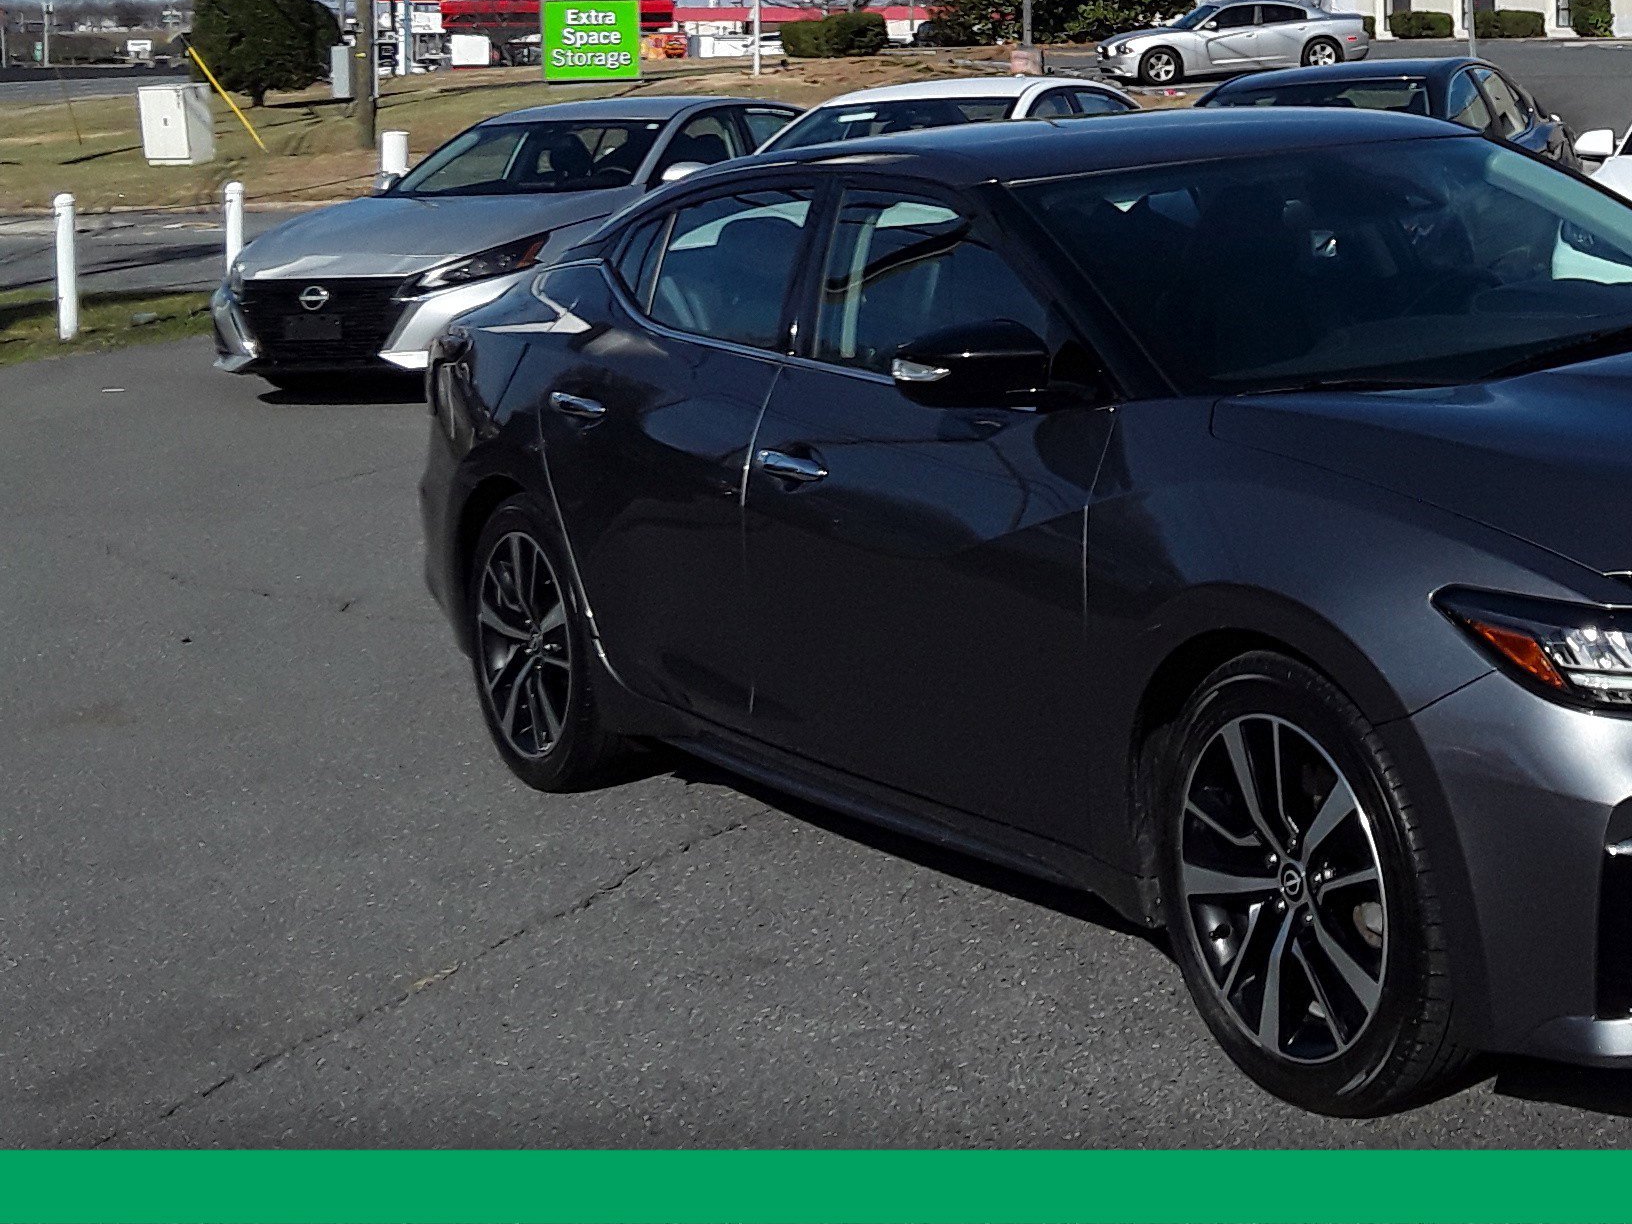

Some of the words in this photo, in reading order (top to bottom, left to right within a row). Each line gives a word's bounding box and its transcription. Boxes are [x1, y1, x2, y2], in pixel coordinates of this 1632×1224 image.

[566, 9, 616, 25] Extra
[561, 28, 622, 47] Space
[552, 48, 632, 69] Storage
